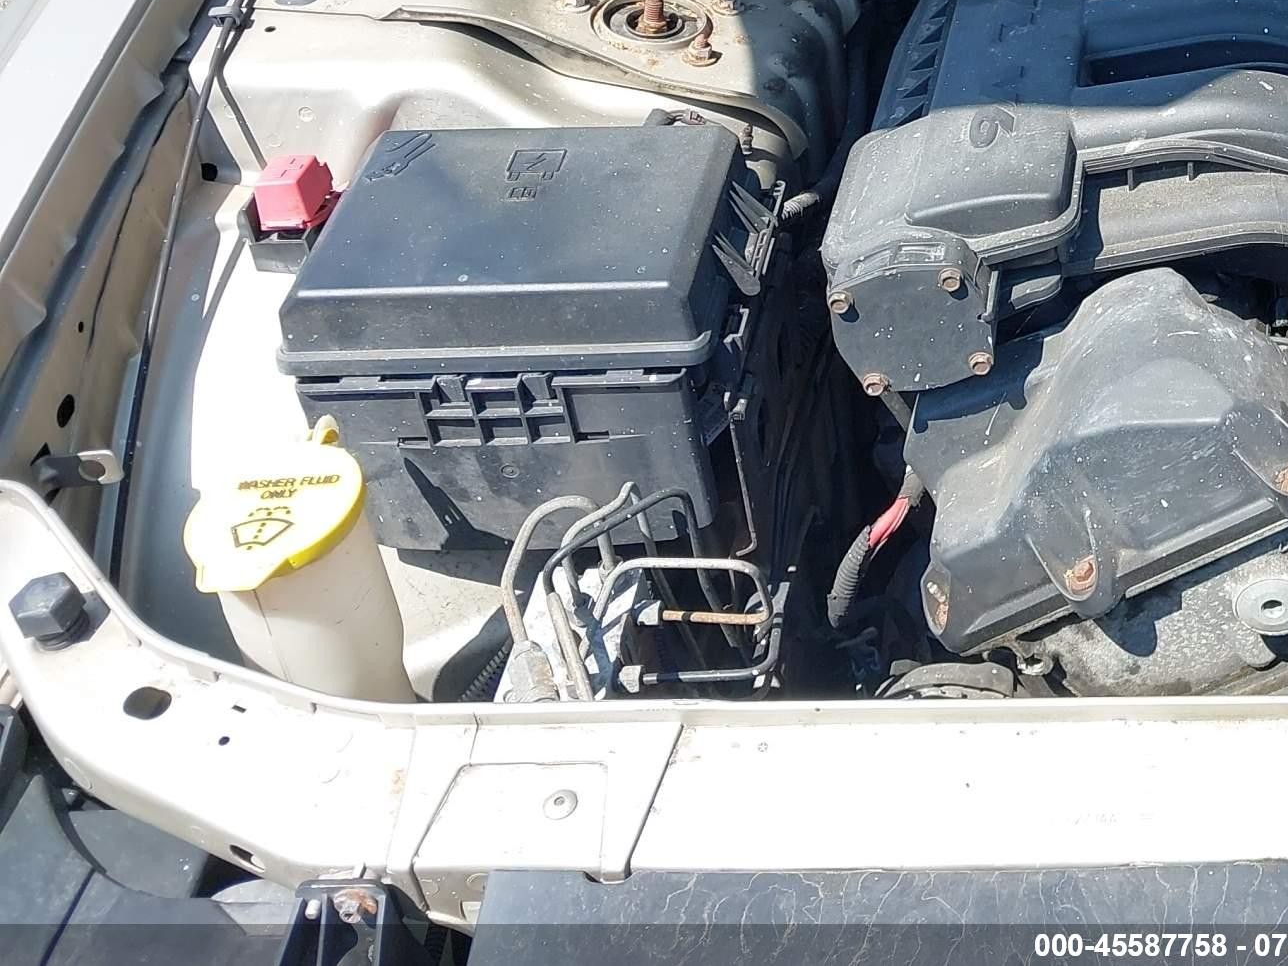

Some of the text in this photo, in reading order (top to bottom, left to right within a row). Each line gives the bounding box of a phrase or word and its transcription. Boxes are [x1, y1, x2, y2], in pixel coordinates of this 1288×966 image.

[238, 474, 340, 490] WASHER FLUID
[261, 489, 297, 500] ONLY
